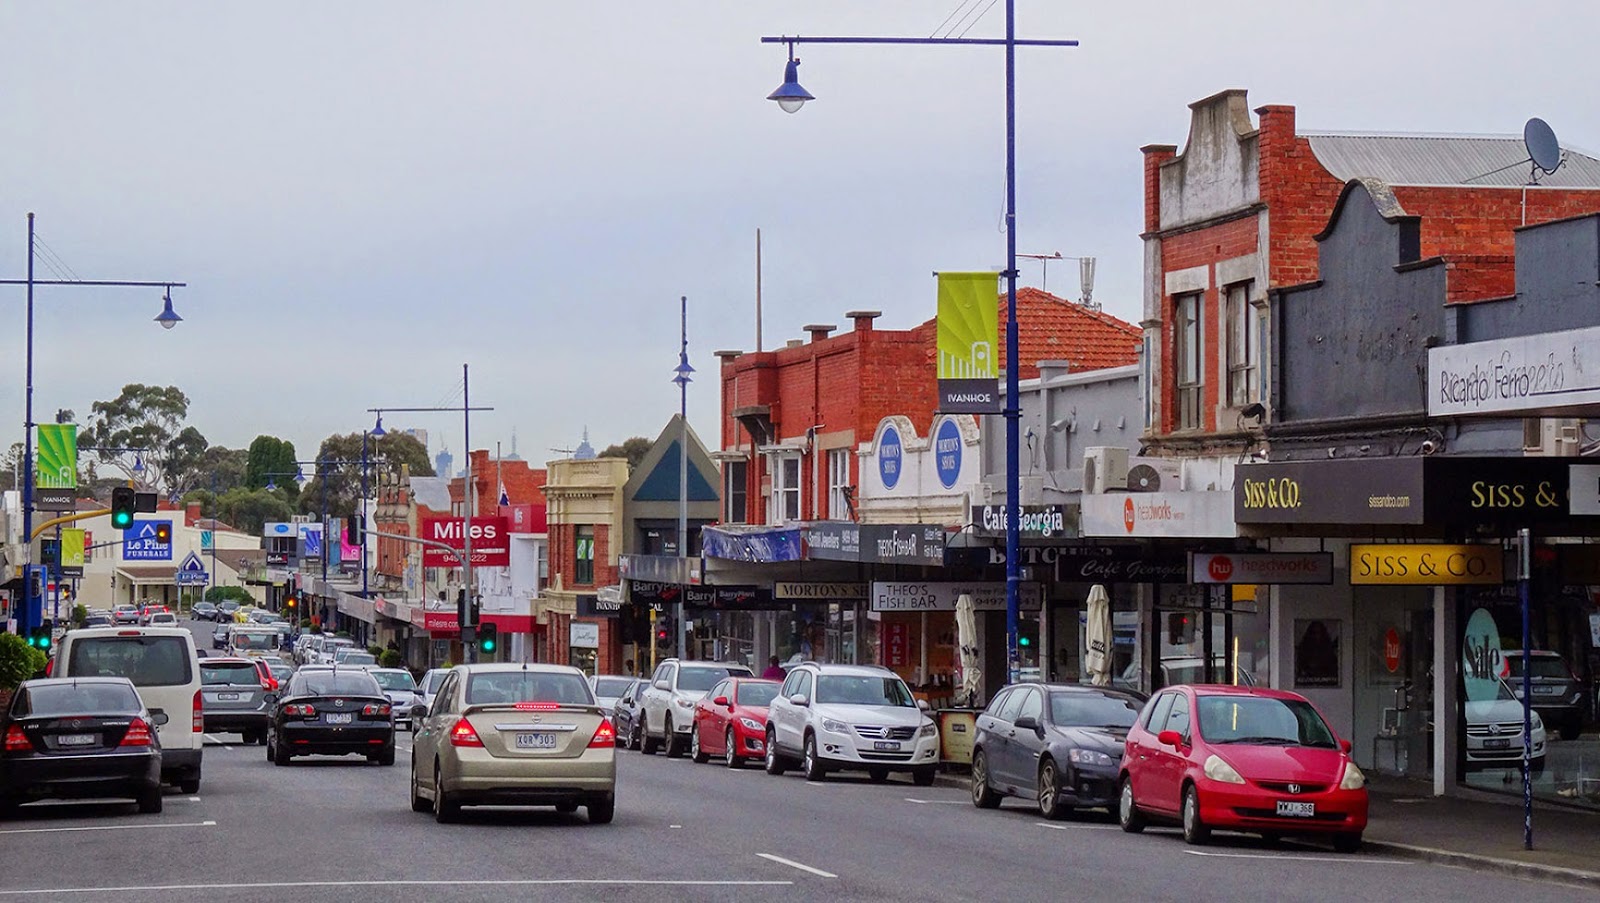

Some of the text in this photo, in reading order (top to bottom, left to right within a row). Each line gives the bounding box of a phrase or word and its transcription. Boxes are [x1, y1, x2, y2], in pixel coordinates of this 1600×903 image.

[1441, 365, 1488, 406] Ricardo
[1495, 366, 1529, 400] Ferro
[948, 394, 990, 402] IVANHOE
[1267, 478, 1278, 508] &
[1471, 481, 1560, 508] SISS &
[1368, 494, 1410, 508] sissandco.com
[1018, 507, 1064, 537] Georgia
[434, 522, 496, 539] Miles
[127, 540, 141, 549] Le
[1241, 558, 1319, 573] headworks
[1360, 553, 1408, 577] SISS
[1418, 553, 1440, 577] &
[782, 584, 848, 597] MORTON'S
[887, 585, 928, 595] THEO'S
[879, 595, 906, 609] FISH
[911, 596, 936, 609] BAR
